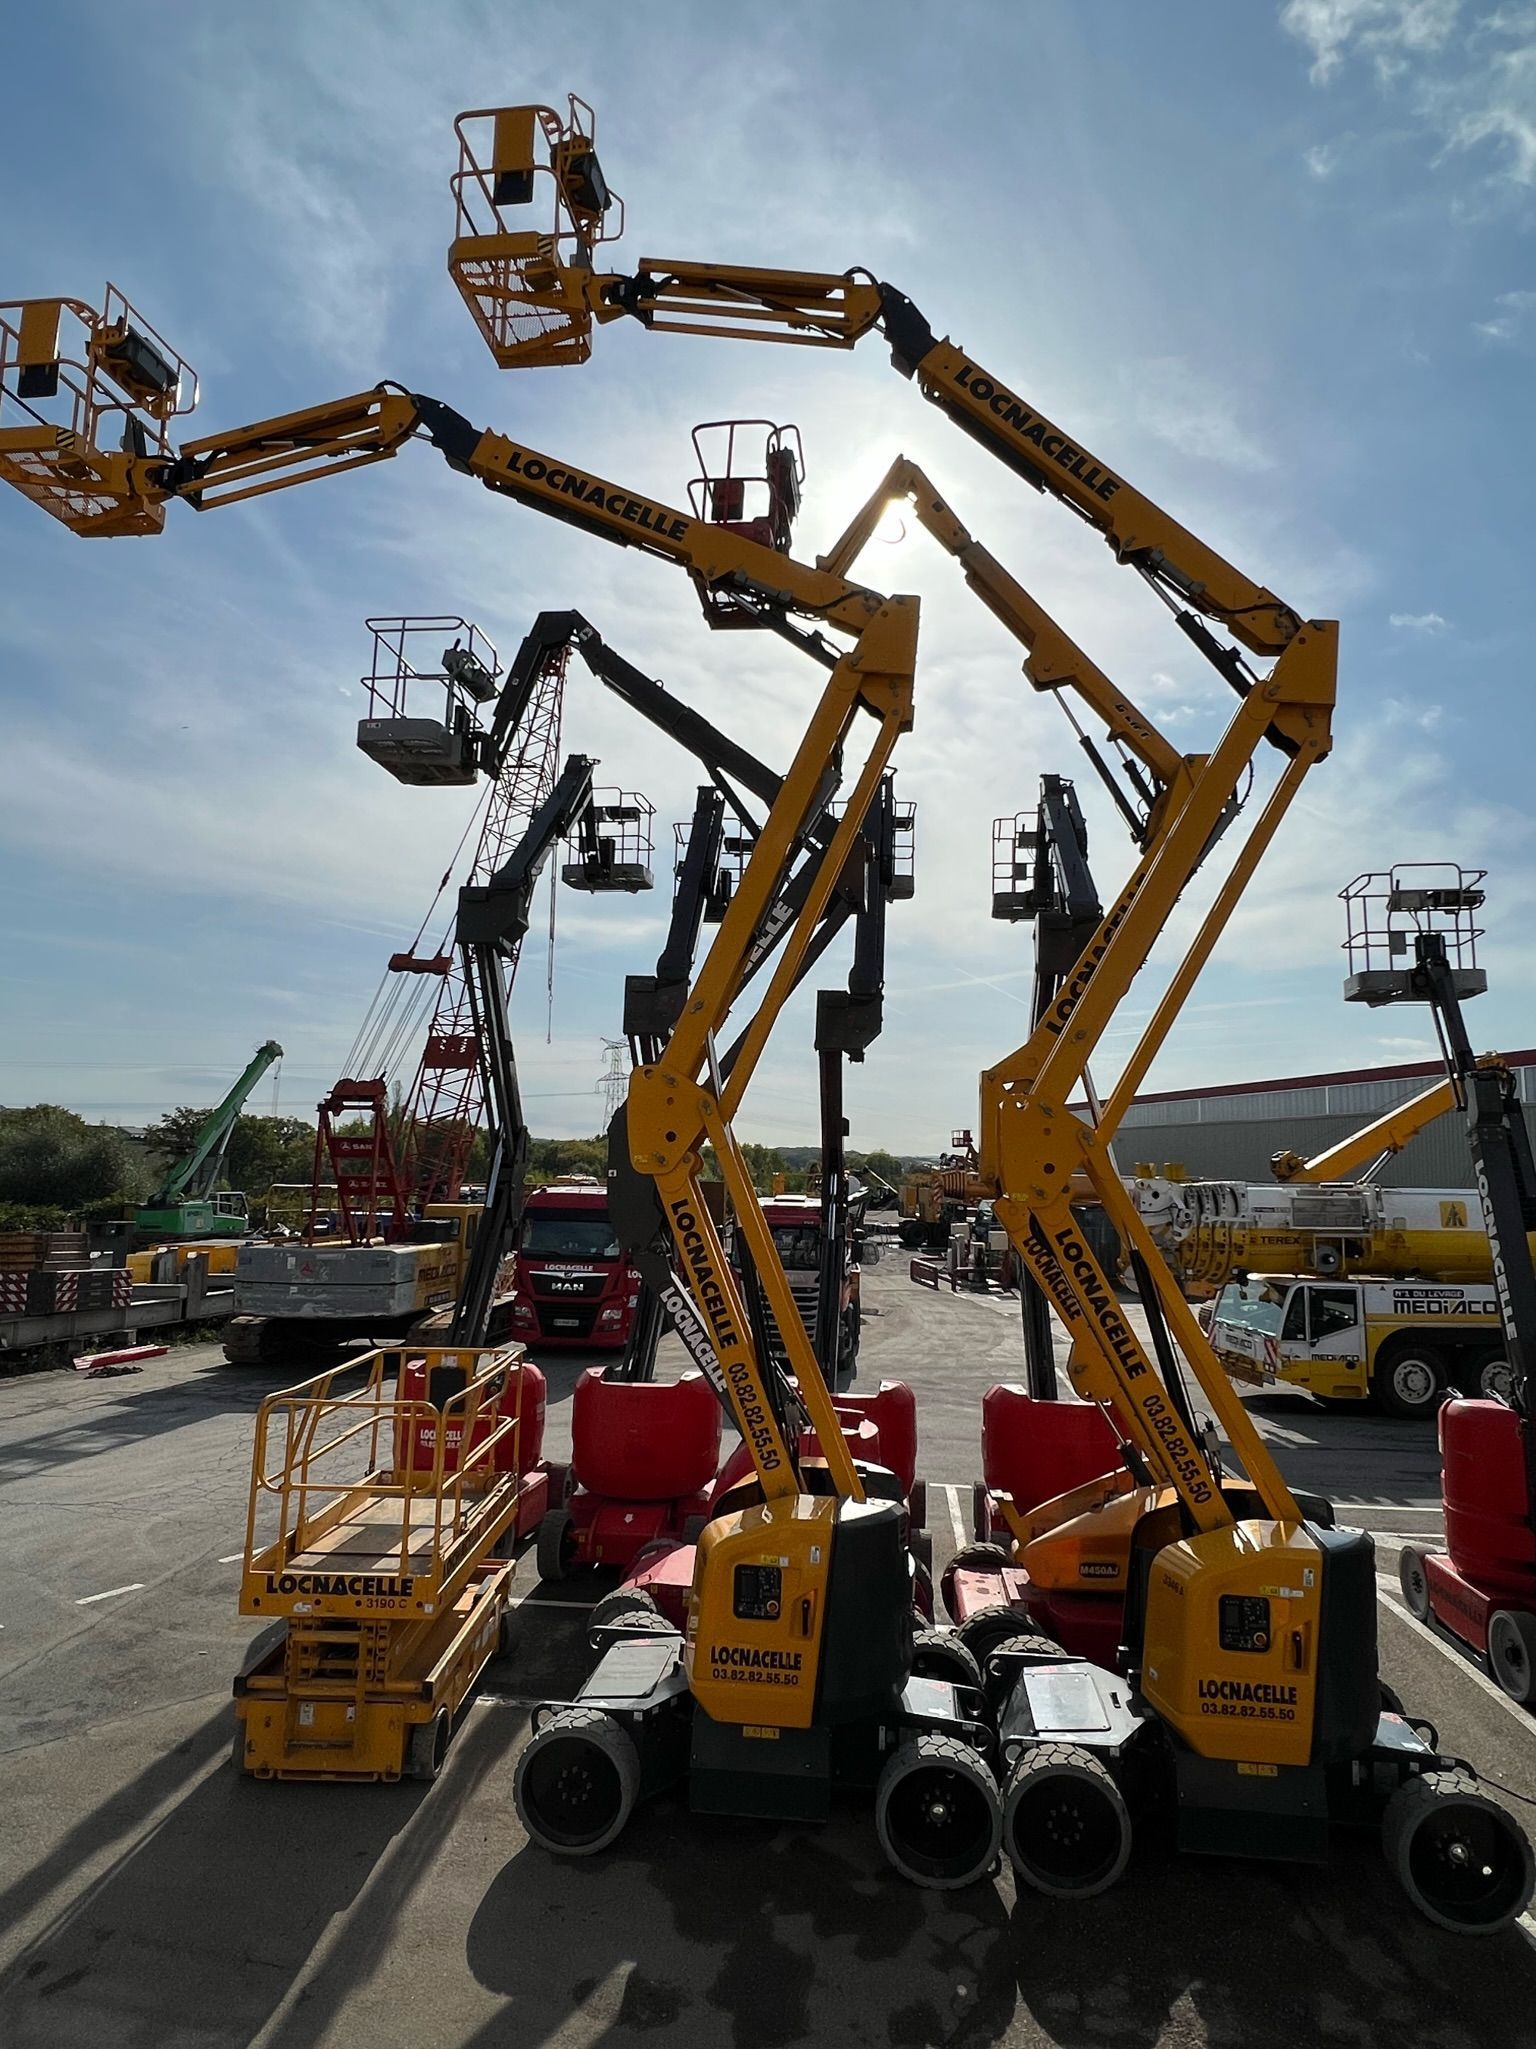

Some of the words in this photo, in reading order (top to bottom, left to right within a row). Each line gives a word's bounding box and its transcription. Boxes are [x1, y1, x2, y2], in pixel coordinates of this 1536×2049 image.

[954, 366, 1120, 502] LOCNACELLE
[507, 451, 689, 542] LOCNACELLE
[545, 1263, 593, 1272] LOCNACELLE
[1260, 1235, 1302, 1245] TEREX
[1475, 1159, 1518, 1341] LOCNACELLE
[551, 1283, 584, 1291] MAN
[670, 1198, 738, 1349] LOCNACELLE
[1022, 1235, 1084, 1321] LOCNACELLE
[1055, 1227, 1146, 1380] LOCNACELLE
[659, 1287, 728, 1393] LOCNACELLE
[727, 1362, 782, 1471] 03.82.82.55.50
[1142, 1394, 1211, 1504] 03.82.82.55.50
[266, 1574, 414, 1597] LOCNACELLE
[366, 1598, 397, 1609] 3190
[399, 1598, 408, 1609] C
[711, 1646, 801, 1670] LOCNACELLE
[712, 1669, 799, 1685] 03.82.82.55.50
[1198, 1680, 1297, 1705] LOCNACELLE
[1201, 1702, 1296, 1721] 03.82.82.55.50
